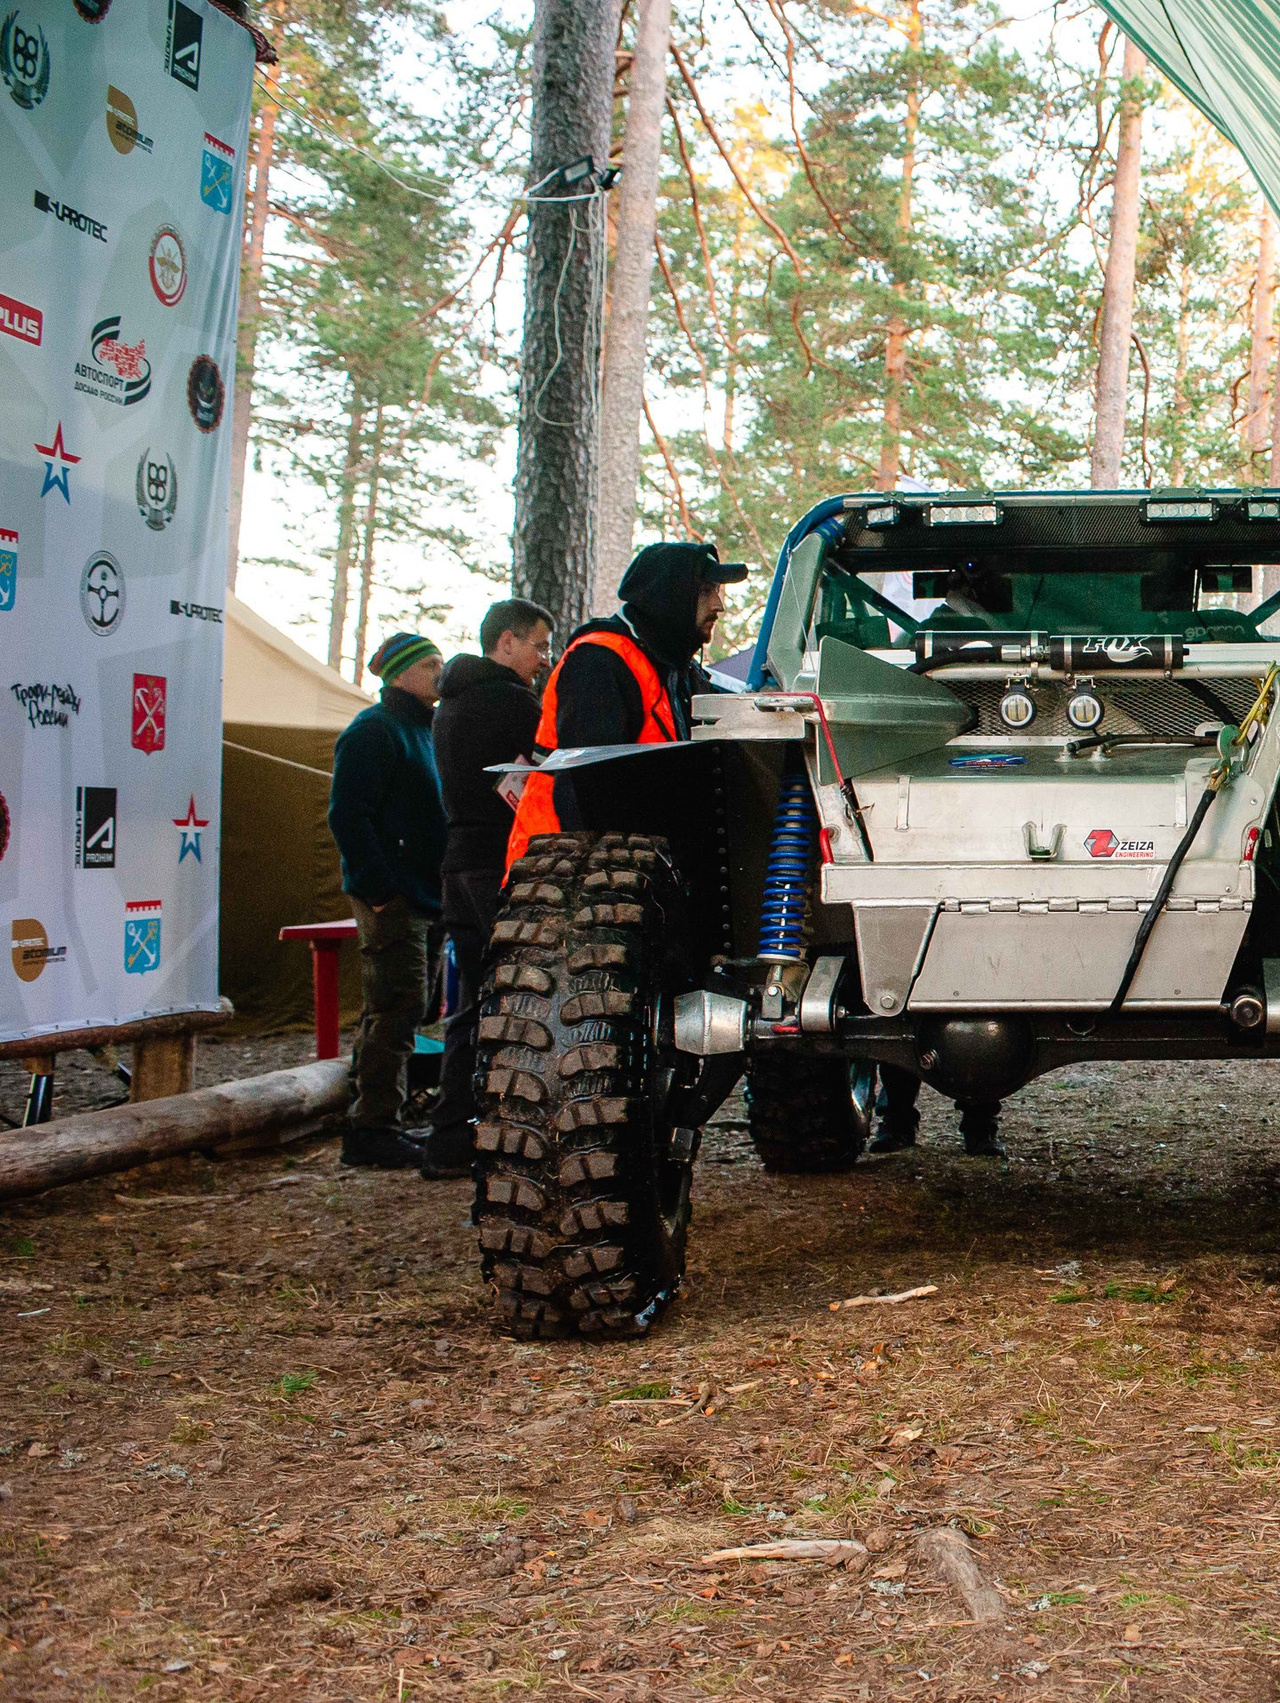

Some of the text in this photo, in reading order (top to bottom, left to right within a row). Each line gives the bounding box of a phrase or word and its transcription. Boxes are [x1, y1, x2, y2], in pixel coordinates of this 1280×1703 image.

[74, 362, 124, 391] АВТОСПОРТ
[1083, 635, 1152, 659] FOX
[1120, 841, 1154, 851] ZEIZA
